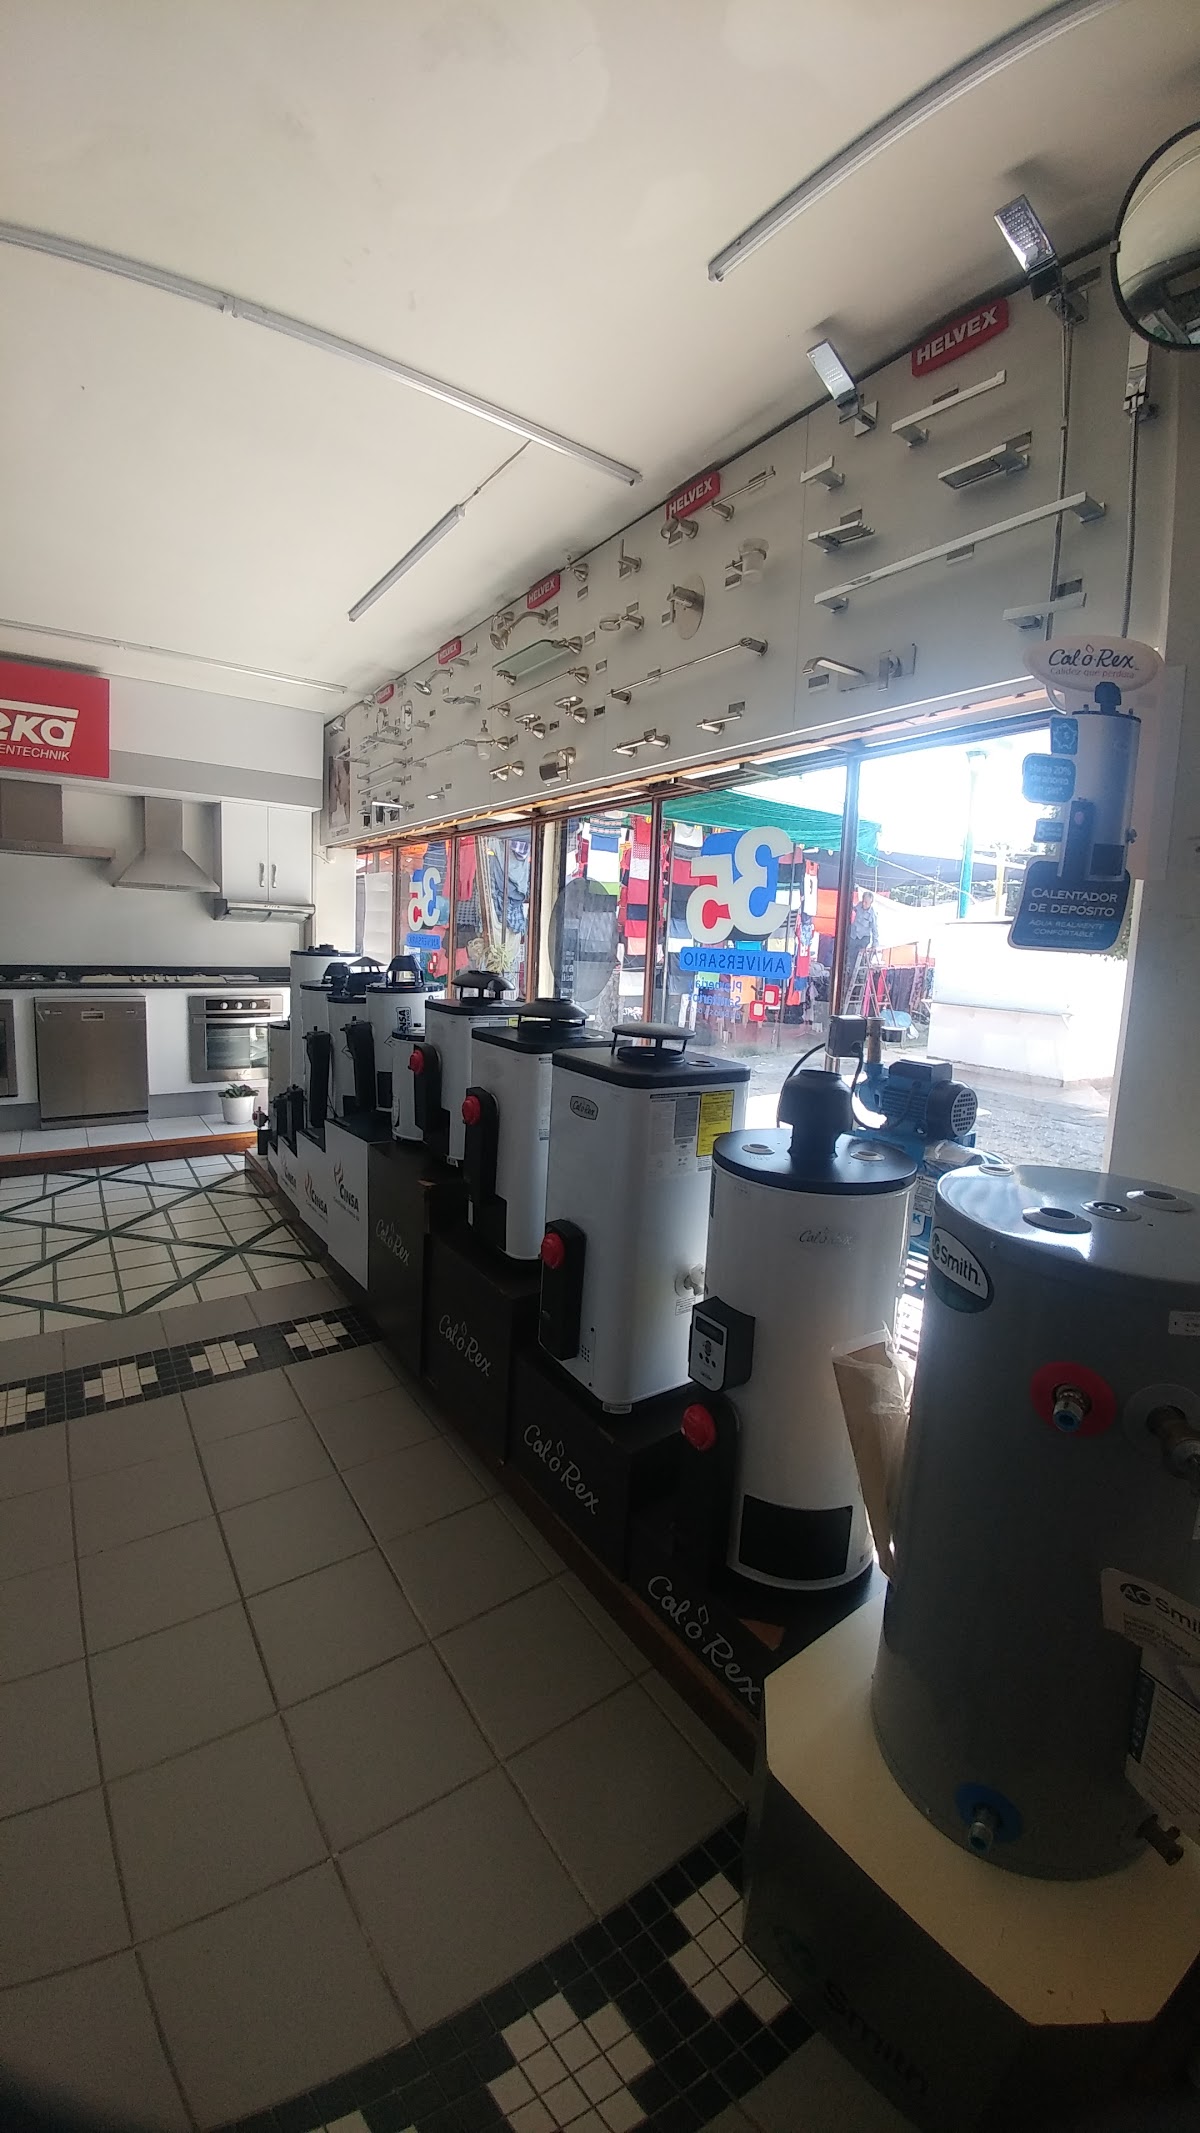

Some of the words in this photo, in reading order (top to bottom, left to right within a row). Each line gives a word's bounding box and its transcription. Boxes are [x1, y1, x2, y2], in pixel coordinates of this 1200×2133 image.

[916, 305, 998, 366] HELVEX
[669, 477, 713, 520] HELVEX
[528, 577, 556, 605] HELVEX
[1031, 887, 1118, 903] CALENTADOR
[1028, 902, 1047, 913] DE
[1050, 902, 1115, 917] DEPÓSITO
[1028, 919, 1052, 927] AGUA
[1033, 928, 1095, 938] CONFORTABLE
[339, 1183, 360, 1213] CINSA
[1155, 1597, 1200, 1634] Smi
